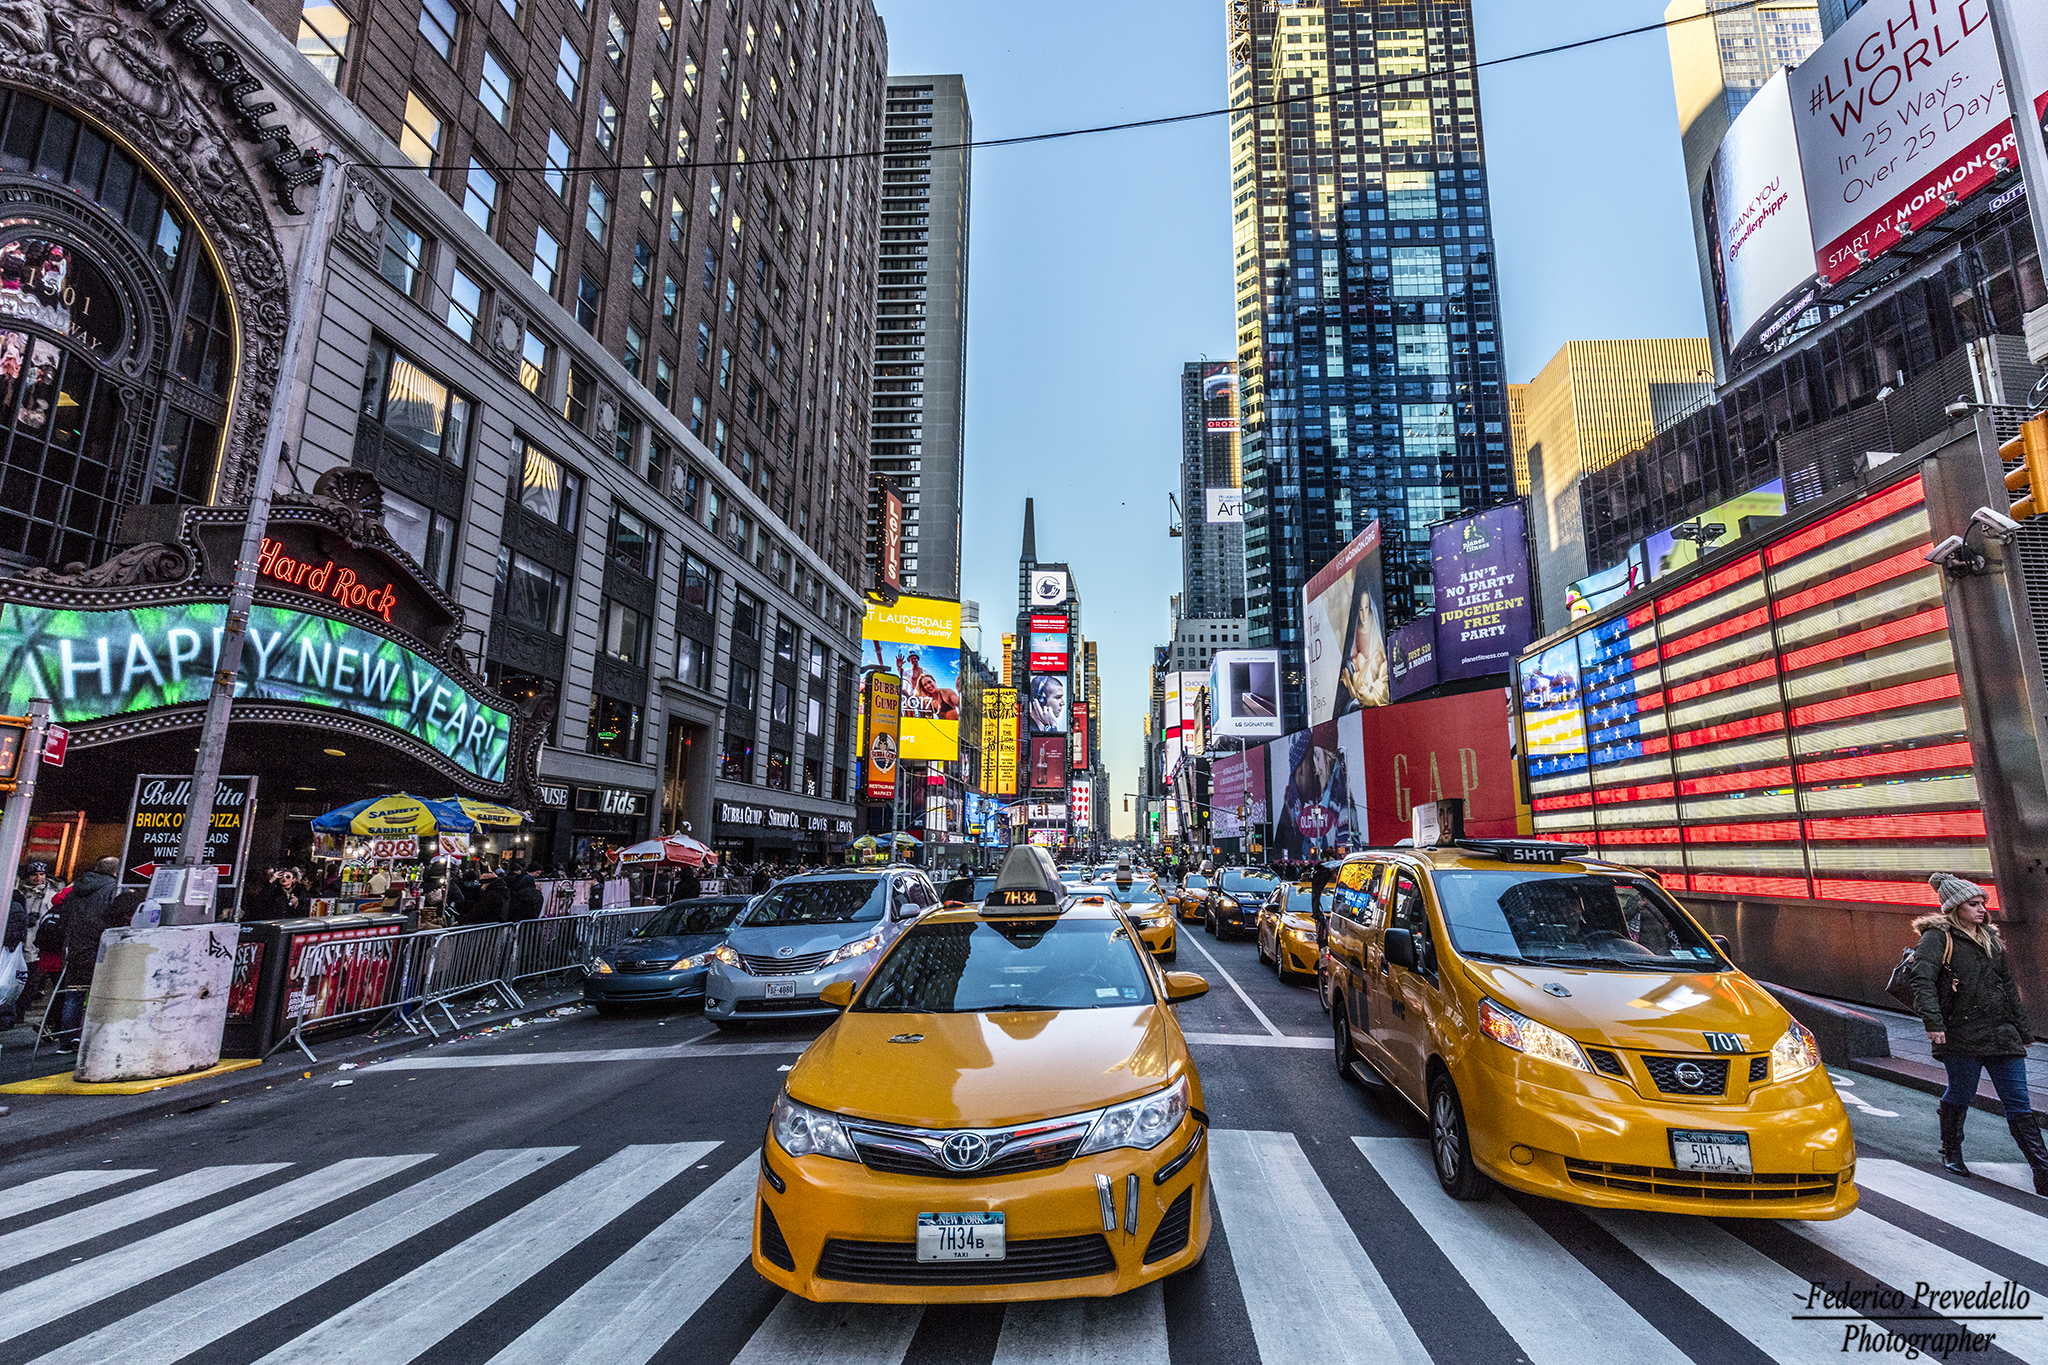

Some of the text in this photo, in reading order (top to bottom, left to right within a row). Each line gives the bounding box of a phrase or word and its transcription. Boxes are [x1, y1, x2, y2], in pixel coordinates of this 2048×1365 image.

[1830, 0, 1989, 138] WORLD
[1838, 71, 1970, 175] In 25 Ways.
[1843, 156, 1898, 204] Over
[1903, 123, 1936, 162] 25
[1728, 176, 1780, 241] THANK YOU
[1728, 191, 1789, 262] @janellerphipps
[1828, 229, 1871, 269] START
[1874, 215, 1892, 238] AT
[1217, 502, 1243, 516] Art
[1462, 537, 1485, 550] planet
[1465, 542, 1490, 553] fitness
[258, 537, 396, 622] Hard Rock
[1459, 565, 1498, 583] AIN'T
[1446, 574, 1515, 598] NO PARTY
[1458, 588, 1504, 607] LIKE A
[1440, 596, 1525, 625] JUDGEMENT
[879, 612, 953, 630] LAUDERDALE
[1463, 613, 1501, 630] FREE
[905, 625, 952, 639] hello sunny
[1460, 624, 1507, 642] PARTY
[1407, 643, 1432, 660] JUST $10
[1461, 650, 1509, 664] planetfitness.com
[1408, 653, 1432, 670] A MONTH
[873, 677, 900, 695] BUBBA
[296, 636, 401, 703] NEW
[410, 670, 496, 762] YEAR!
[875, 694, 898, 711] GUMP
[901, 695, 934, 710] 2017
[1000, 744, 1015, 752] KING
[1393, 747, 1479, 823] GAP
[602, 788, 636, 815] Lids
[135, 812, 173, 828] BRICK
[209, 813, 241, 828] PIZZA
[368, 806, 421, 819] SABRETT
[476, 813, 511, 823] SABRETT
[721, 803, 744, 823] BUBBA
[744, 806, 763, 825] GUMP
[768, 808, 790, 827] SHRIMP
[1300, 813, 1328, 828] OLD NVY
[367, 825, 418, 834] SABRETT
[807, 816, 828, 831] Levi's
[836, 819, 853, 833] Levi's
[143, 832, 182, 844] PASTAS
[622, 853, 640, 862] NUTS
[1003, 891, 1037, 905] 7H34
[1704, 1032, 1745, 1052] 701
[1691, 1135, 1728, 1144] NEW YORK
[938, 1215, 984, 1226] NEW YORK
